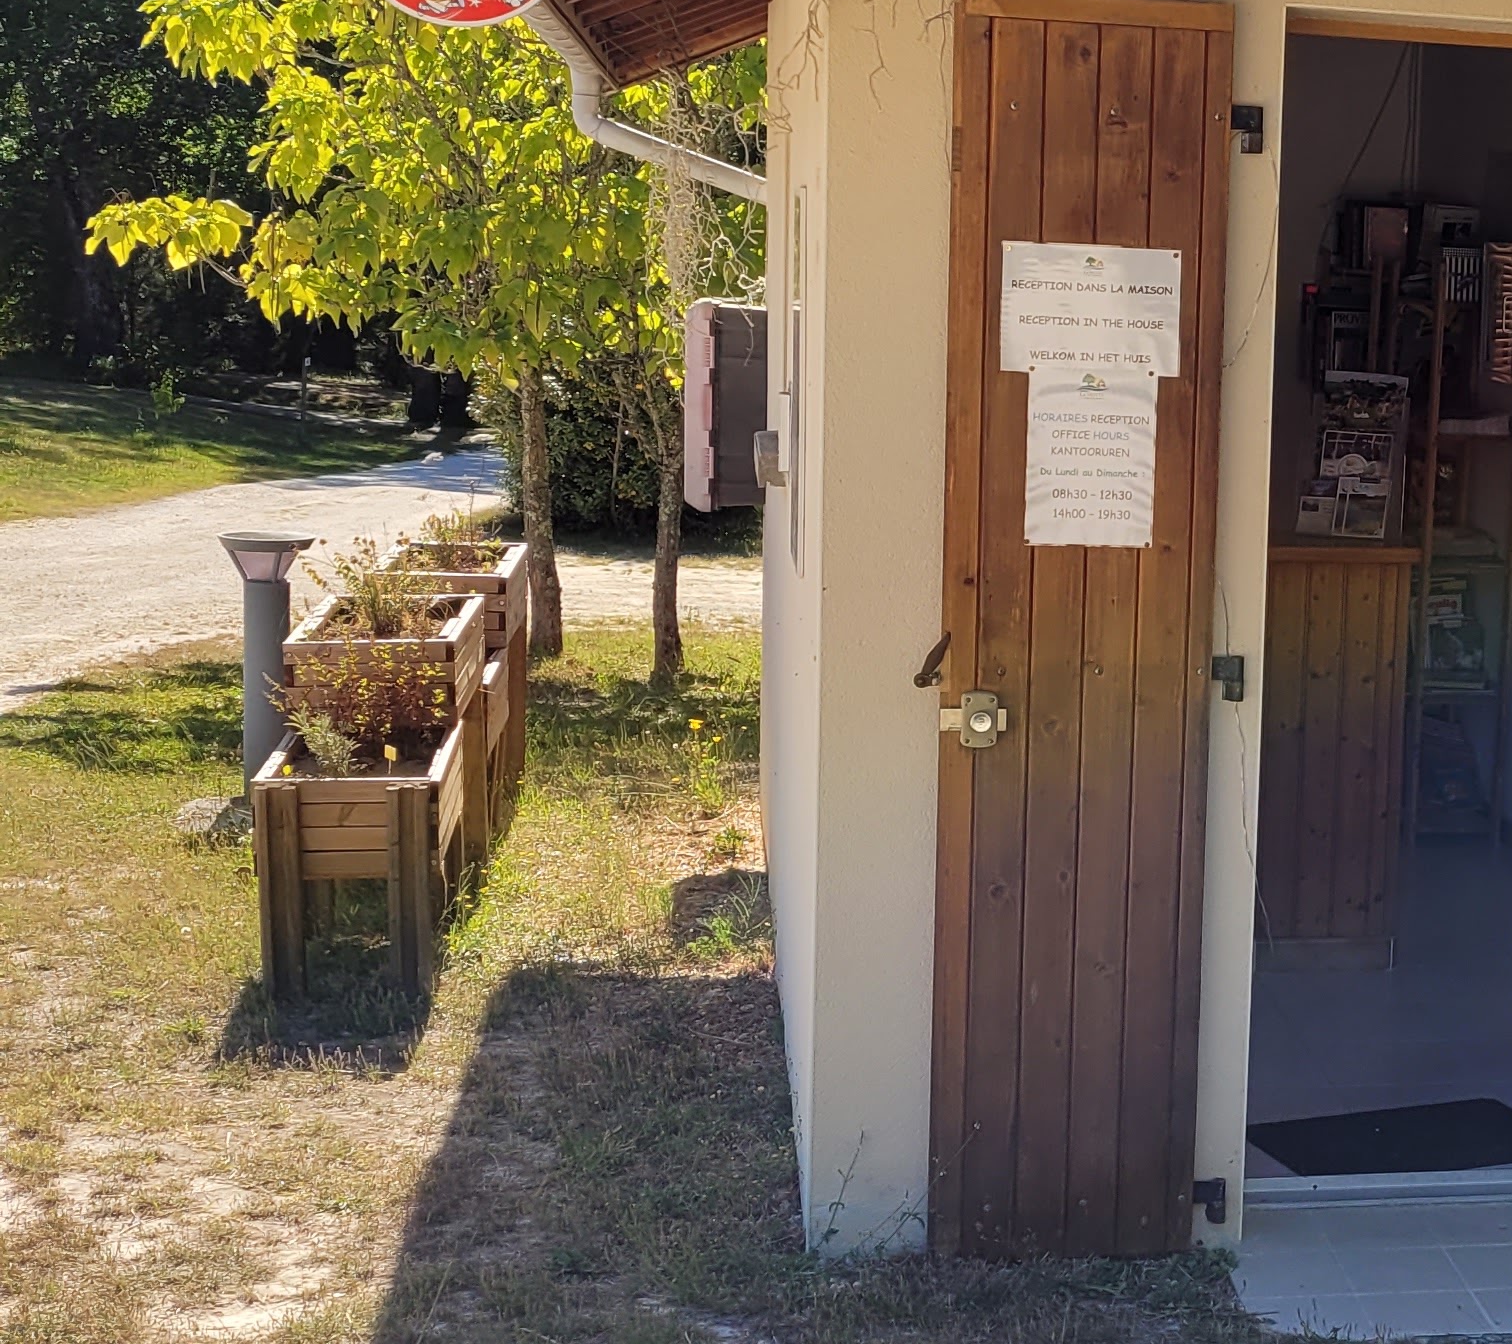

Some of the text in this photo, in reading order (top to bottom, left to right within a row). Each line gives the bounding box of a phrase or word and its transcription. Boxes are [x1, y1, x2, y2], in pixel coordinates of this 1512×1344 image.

[1011, 280, 1173, 295] RECEPTION DANS LA MAISON
[1019, 315, 1164, 330] RECEPTION IN THE HOUSE
[1029, 350, 1152, 364] WELKOM IN HET HUIS
[1033, 412, 1150, 425] HORAIRES RECEPTION
[1052, 430, 1130, 441] OFFICE HOURS
[1051, 447, 1130, 457] KANTOORUREN
[1040, 467, 1052, 476] Du
[1056, 467, 1078, 476] Lundi
[1096, 469, 1138, 478] Dimanche
[1052, 489, 1087, 499] 08h30
[1099, 490, 1132, 501] 12h30
[1053, 509, 1086, 519] 14h00
[1098, 510, 1131, 520] 19h30
